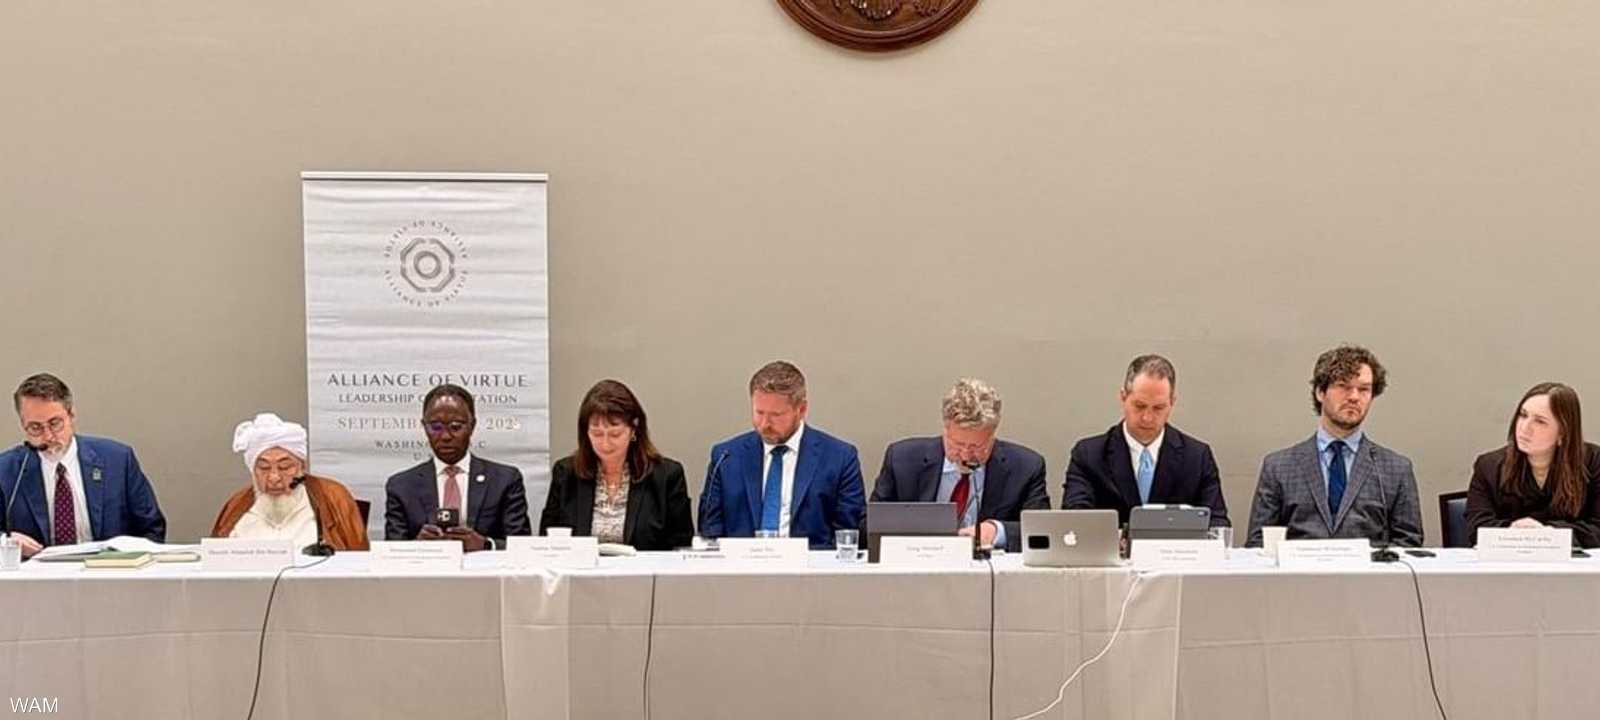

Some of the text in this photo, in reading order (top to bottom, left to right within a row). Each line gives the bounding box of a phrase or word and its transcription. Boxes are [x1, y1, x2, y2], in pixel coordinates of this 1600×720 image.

[327, 373, 529, 388] ALLIANCE OF VIRTUE
[338, 393, 415, 404] LEADERSHIP
